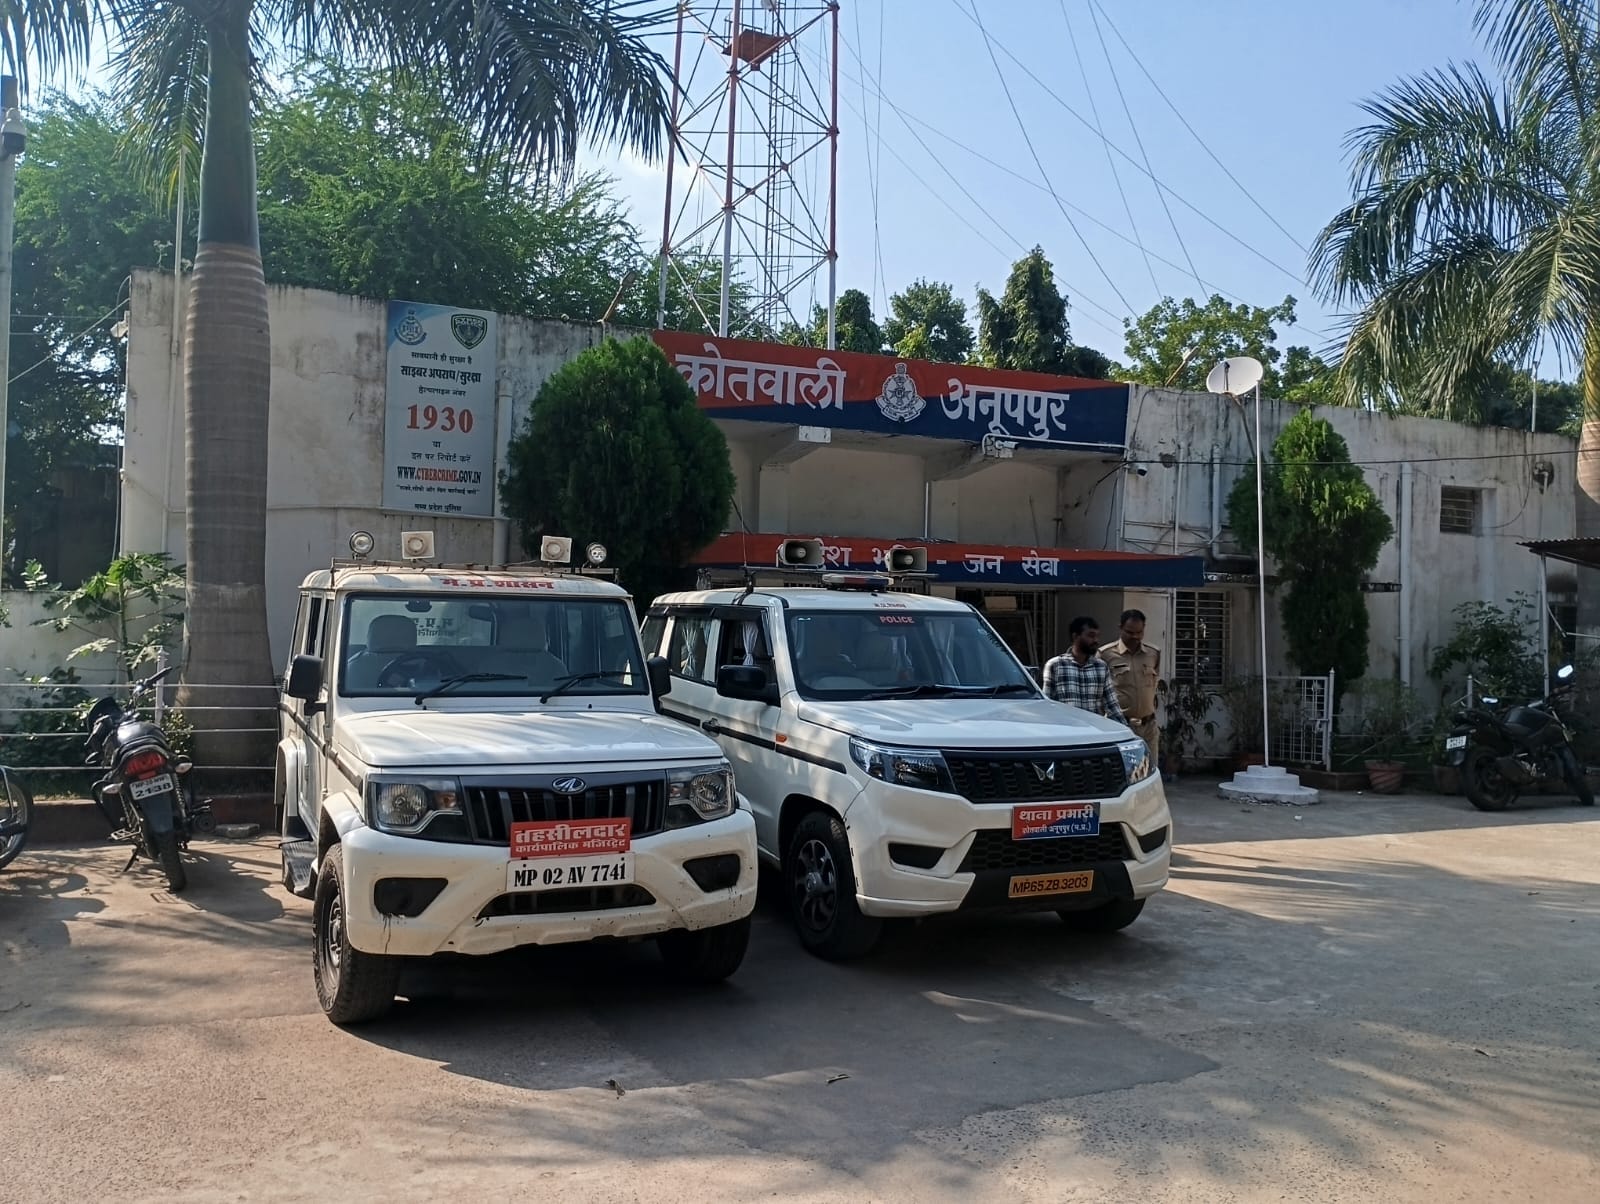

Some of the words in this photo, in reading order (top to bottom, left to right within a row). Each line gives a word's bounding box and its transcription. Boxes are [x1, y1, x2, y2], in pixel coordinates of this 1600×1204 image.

[400, 365, 427, 378] साइबर
[675, 342, 846, 411] कोतवाली
[940, 378, 1070, 438] अनूपपुर
[406, 403, 473, 433] 1930
[963, 553, 1004, 576] जन
[1021, 549, 1060, 577] सेवा
[879, 616, 915, 624] POLICE
[1019, 809, 1052, 821] थाना
[1056, 804, 1094, 821] प्रभारी
[514, 823, 627, 844] तहसीलदार
[515, 841, 579, 853] कार्यपालिक
[514, 869, 537, 887] MP
[543, 867, 563, 885] 02
[567, 866, 587, 884] AV
[591, 862, 626, 882] 7741
